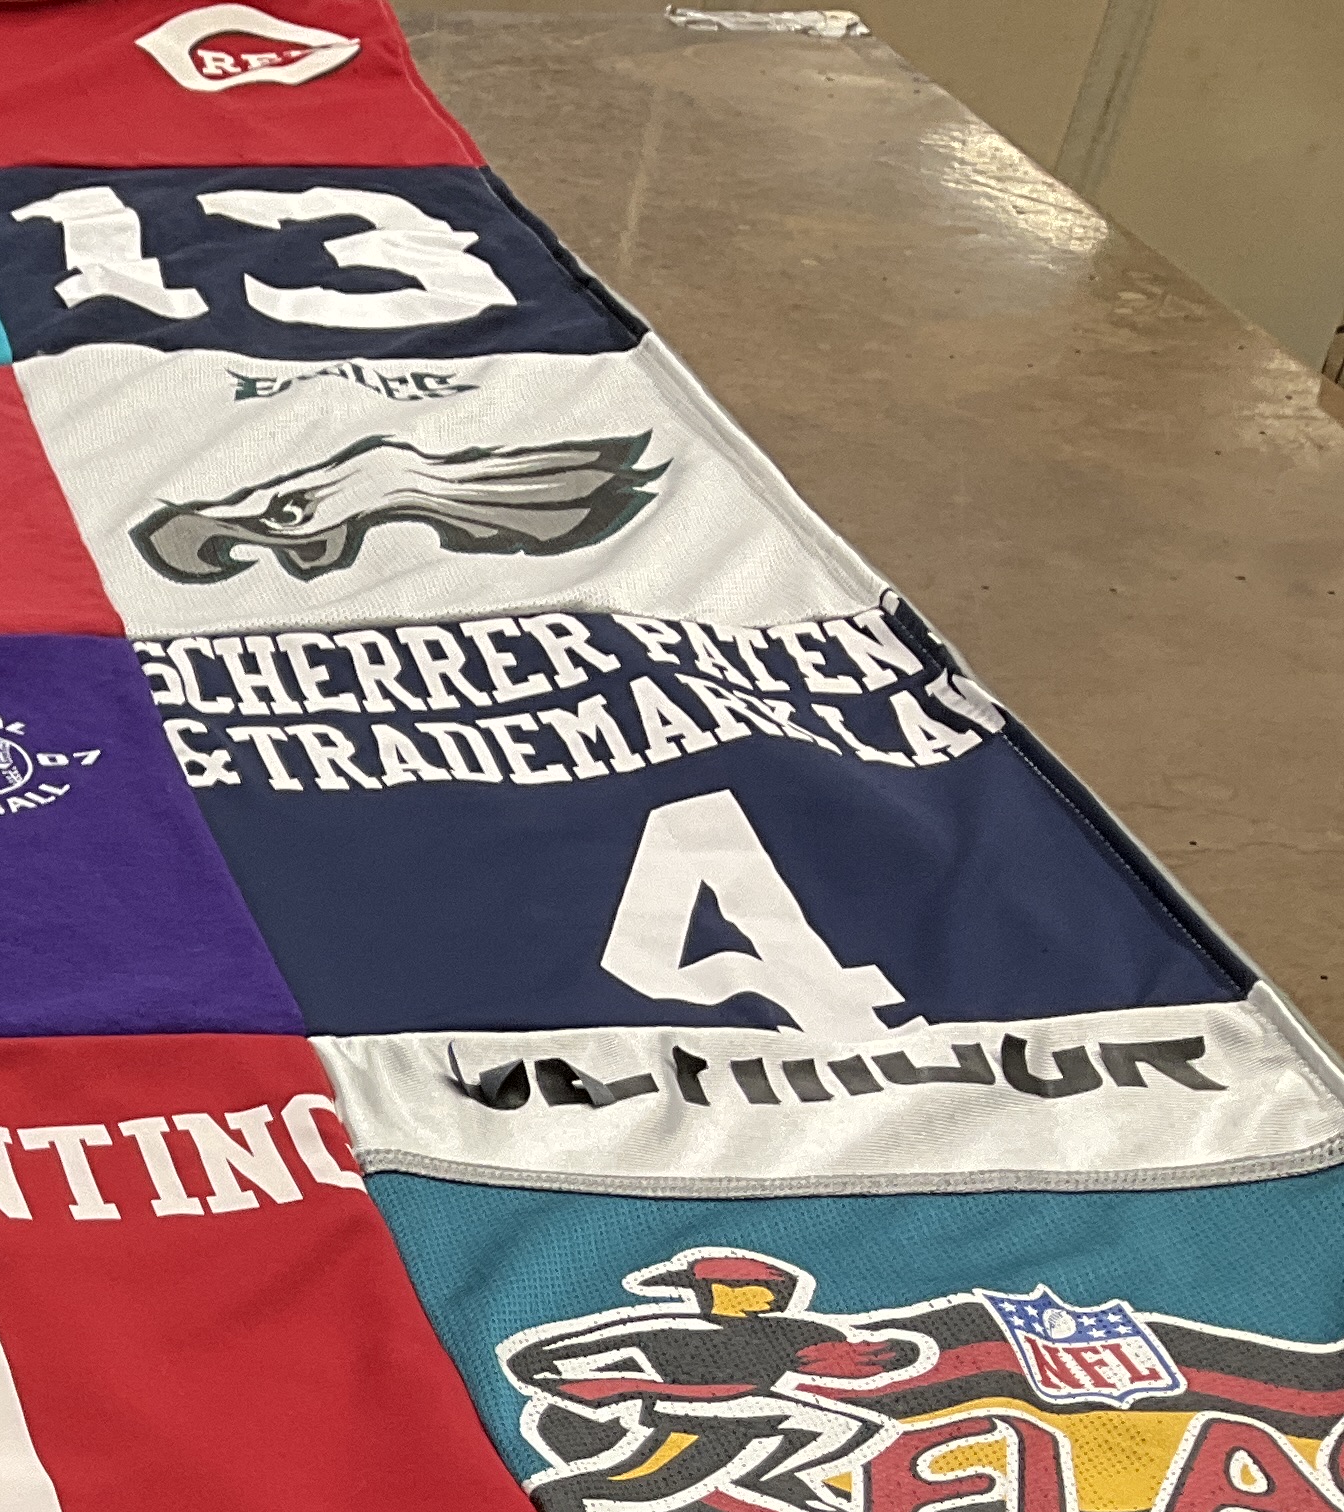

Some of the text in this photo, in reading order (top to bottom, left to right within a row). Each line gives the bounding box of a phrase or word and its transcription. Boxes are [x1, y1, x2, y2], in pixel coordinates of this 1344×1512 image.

[11, 186, 517, 329] 13
[132, 608, 942, 716] SCHERRER PATEN
[225, 671, 843, 793] TRADEMARK
[601, 789, 932, 1042] 4
[1024, 1334, 1164, 1390] NFL
